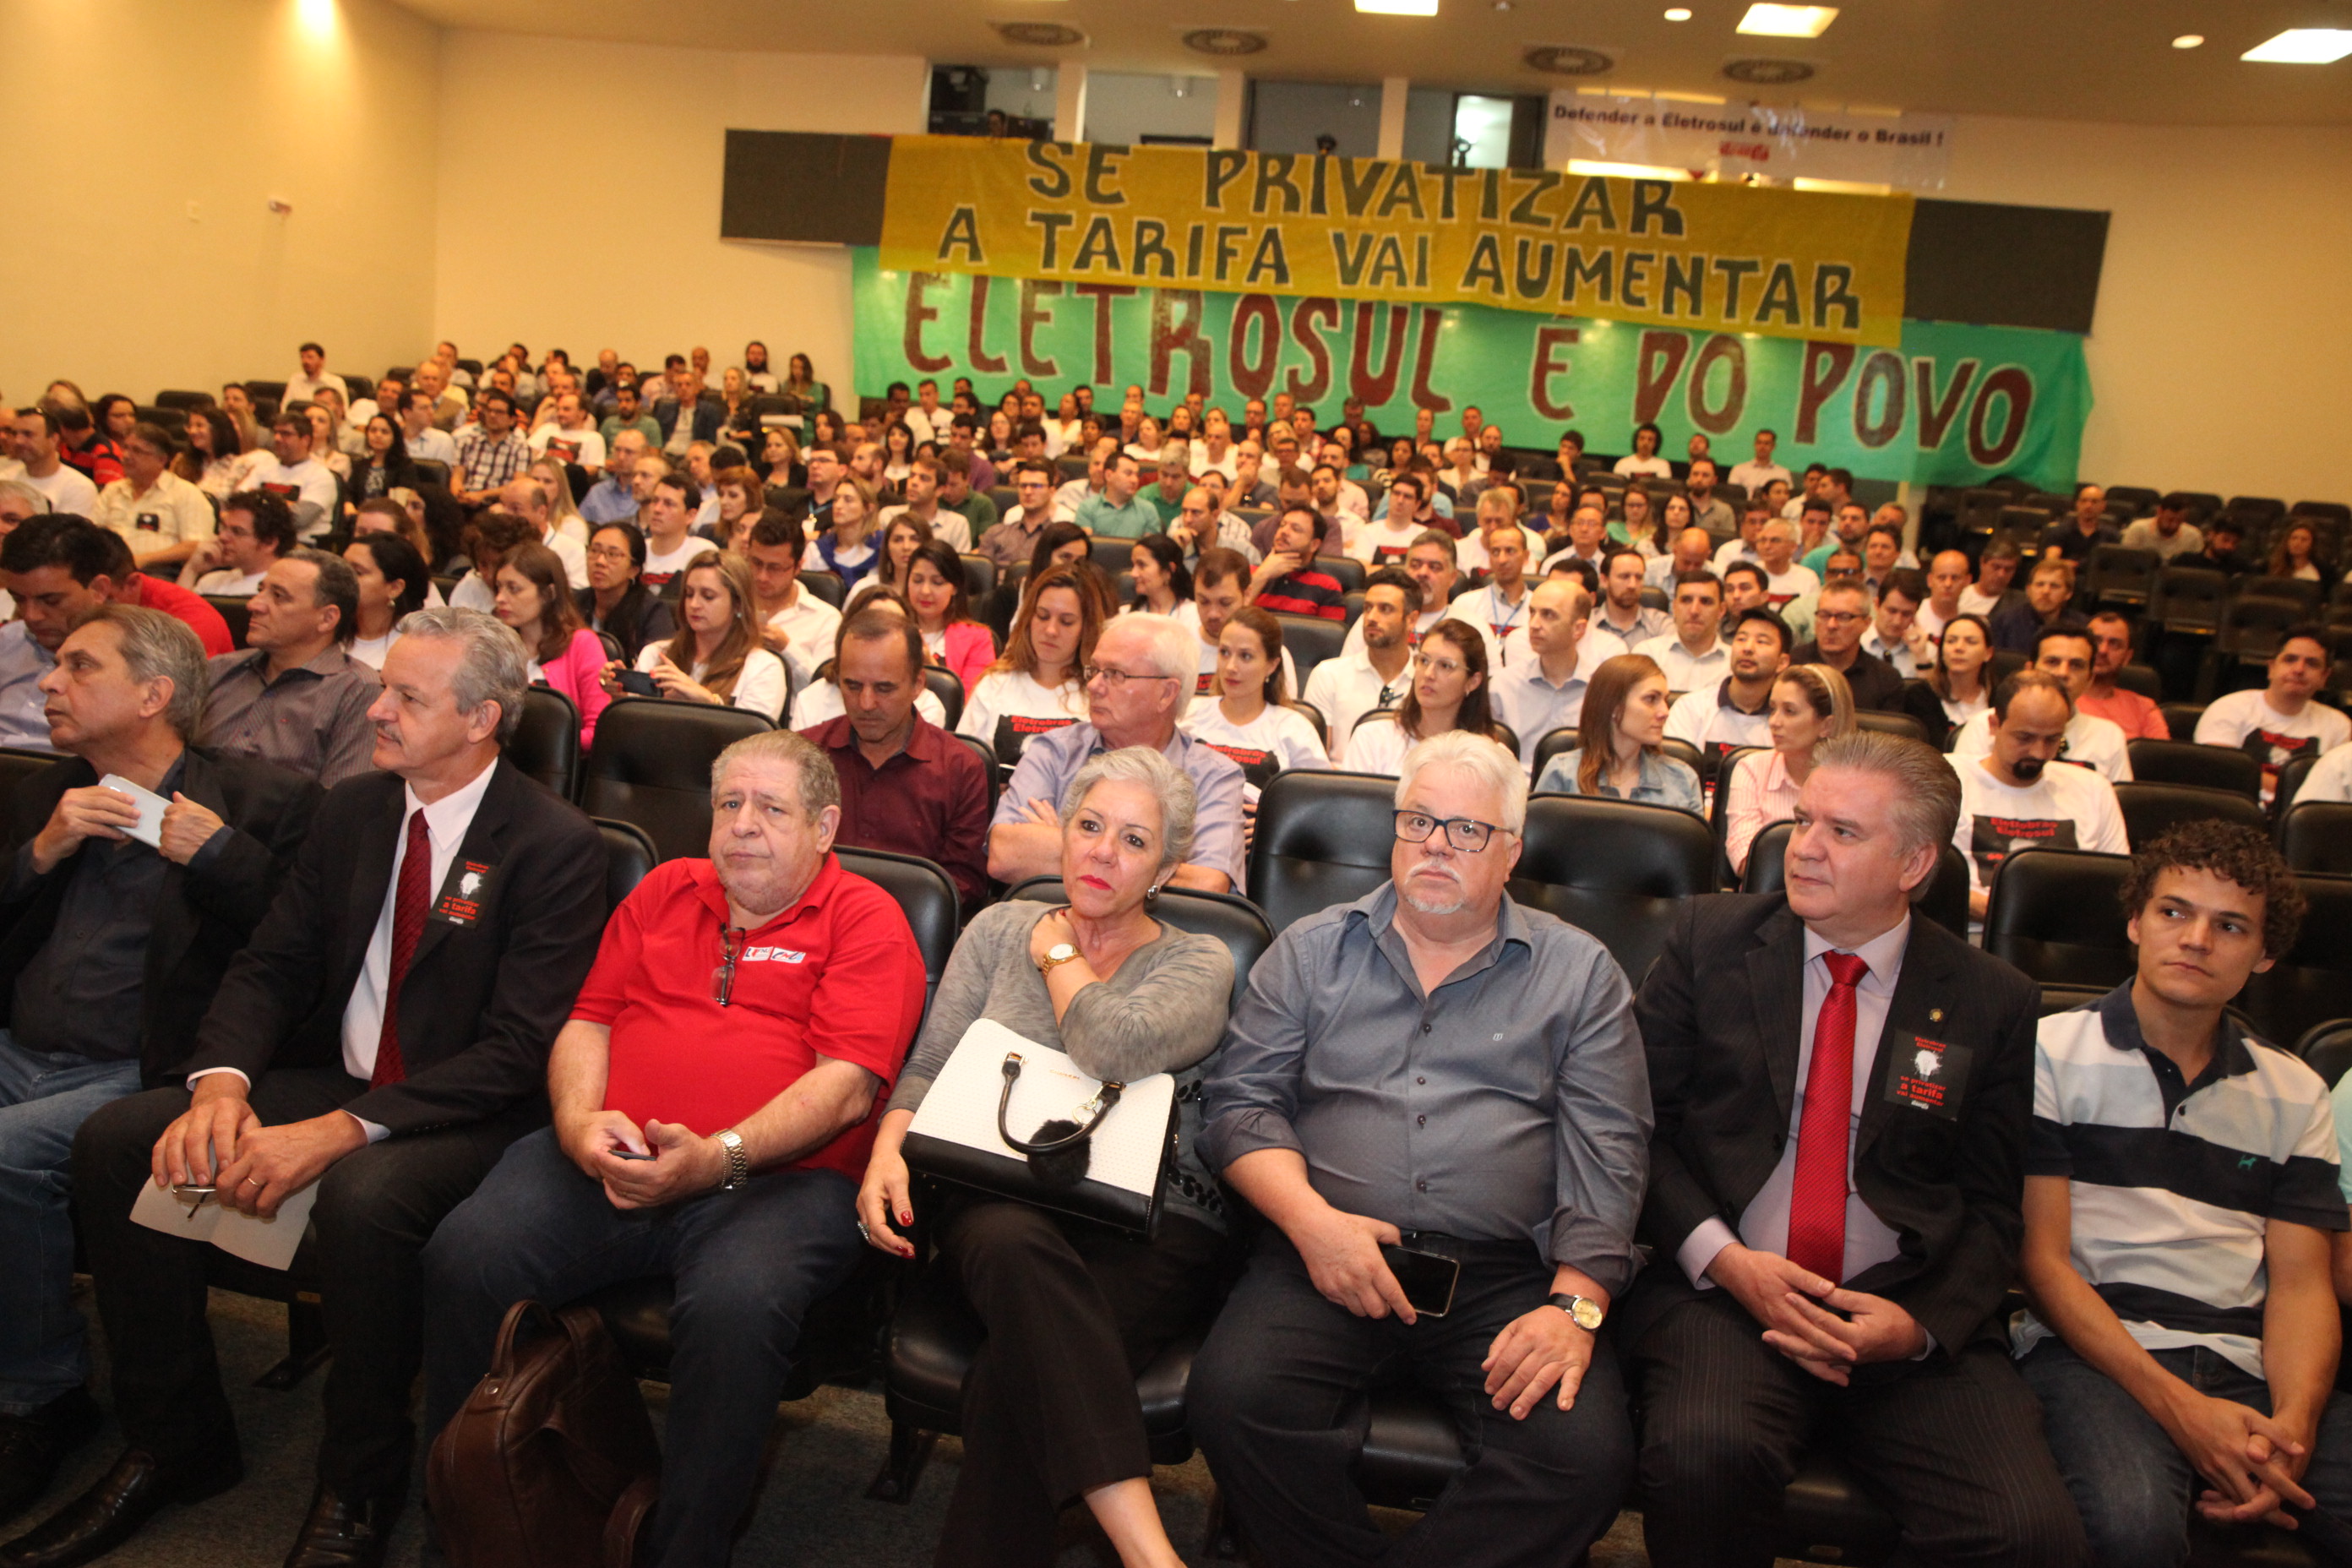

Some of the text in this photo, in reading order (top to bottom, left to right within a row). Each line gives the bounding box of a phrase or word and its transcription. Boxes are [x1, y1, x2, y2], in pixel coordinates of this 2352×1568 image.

[1554, 106, 1638, 125] Defender
[1643, 115, 1655, 125] a
[1662, 112, 1745, 133] Eletrosul
[1857, 130, 1869, 143] o
[1876, 128, 1931, 145] Brasil
[1026, 142, 1685, 238] SE PRIVATIZAR
[937, 204, 1860, 330] A TARIFA VAI AUMENTAR
[903, 272, 1451, 412] ELETROSUL
[1632, 329, 1746, 434] DO
[1794, 340, 2034, 466] POVO
[451, 902, 476, 915] tarifa
[1911, 1084, 1943, 1099] tarifa
